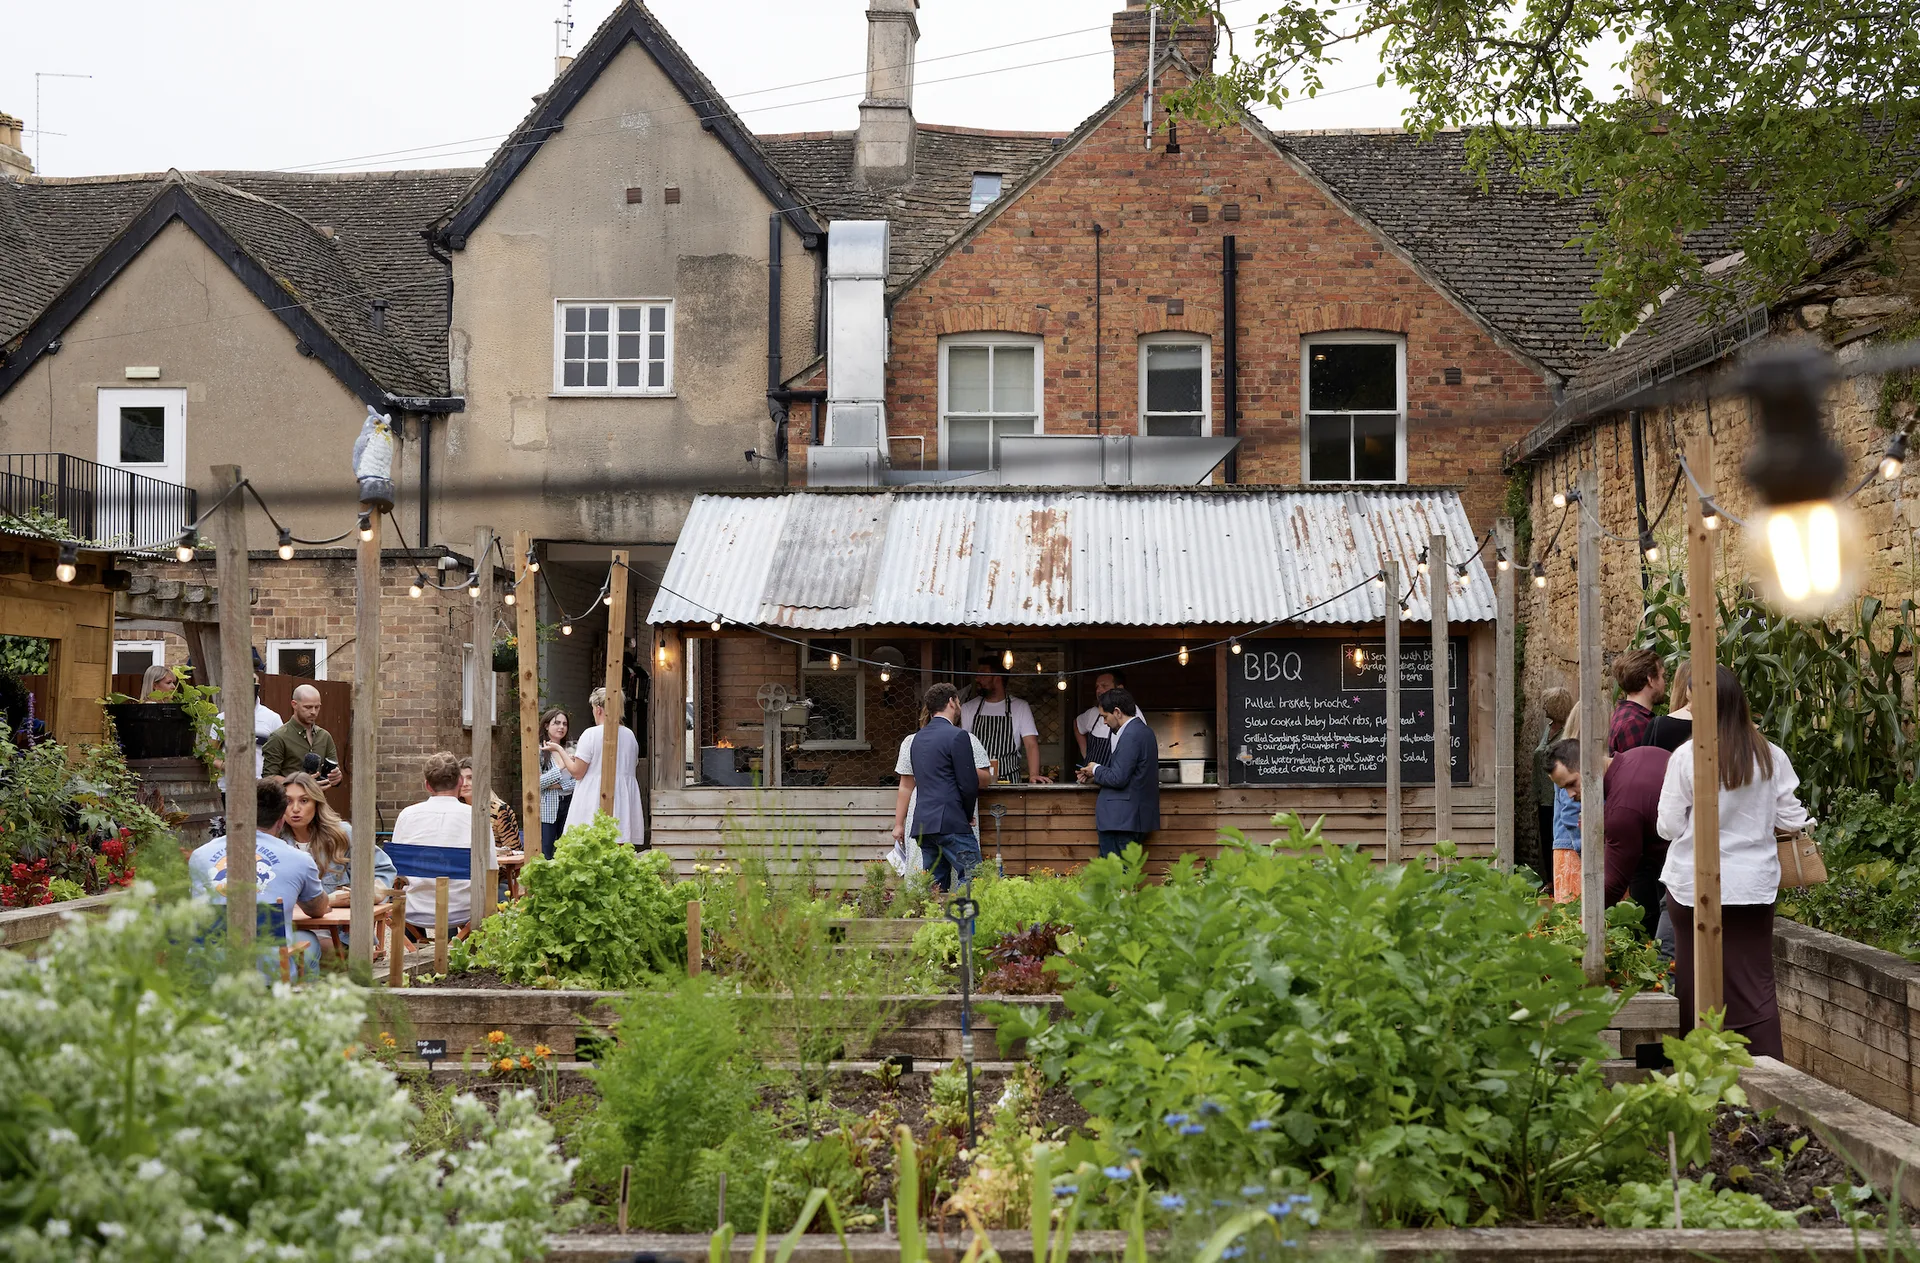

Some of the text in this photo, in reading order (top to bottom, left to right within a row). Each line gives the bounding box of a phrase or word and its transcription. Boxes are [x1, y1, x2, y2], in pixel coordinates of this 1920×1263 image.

[1400, 650, 1422, 661] with
[1245, 652, 1302, 681] BBQ
[1400, 672, 1423, 682] beans
[1245, 697, 1275, 710] Pulled
[1314, 696, 1353, 709] brioche
[1244, 716, 1268, 729] Slow
[1304, 714, 1326, 730] baby
[1328, 713, 1350, 726] back
[1352, 714, 1373, 727] ribs,
[1243, 733, 1267, 743] Grilled
[1362, 734, 1379, 744] baba
[1301, 741, 1339, 750] cucumber
[1316, 756, 1335, 768] feta
[1336, 752, 1352, 763] and
[1258, 763, 1289, 776] toasted
[1328, 764, 1336, 773] &
[1359, 762, 1378, 771] nuts
[258, 846, 280, 865] BREAK
